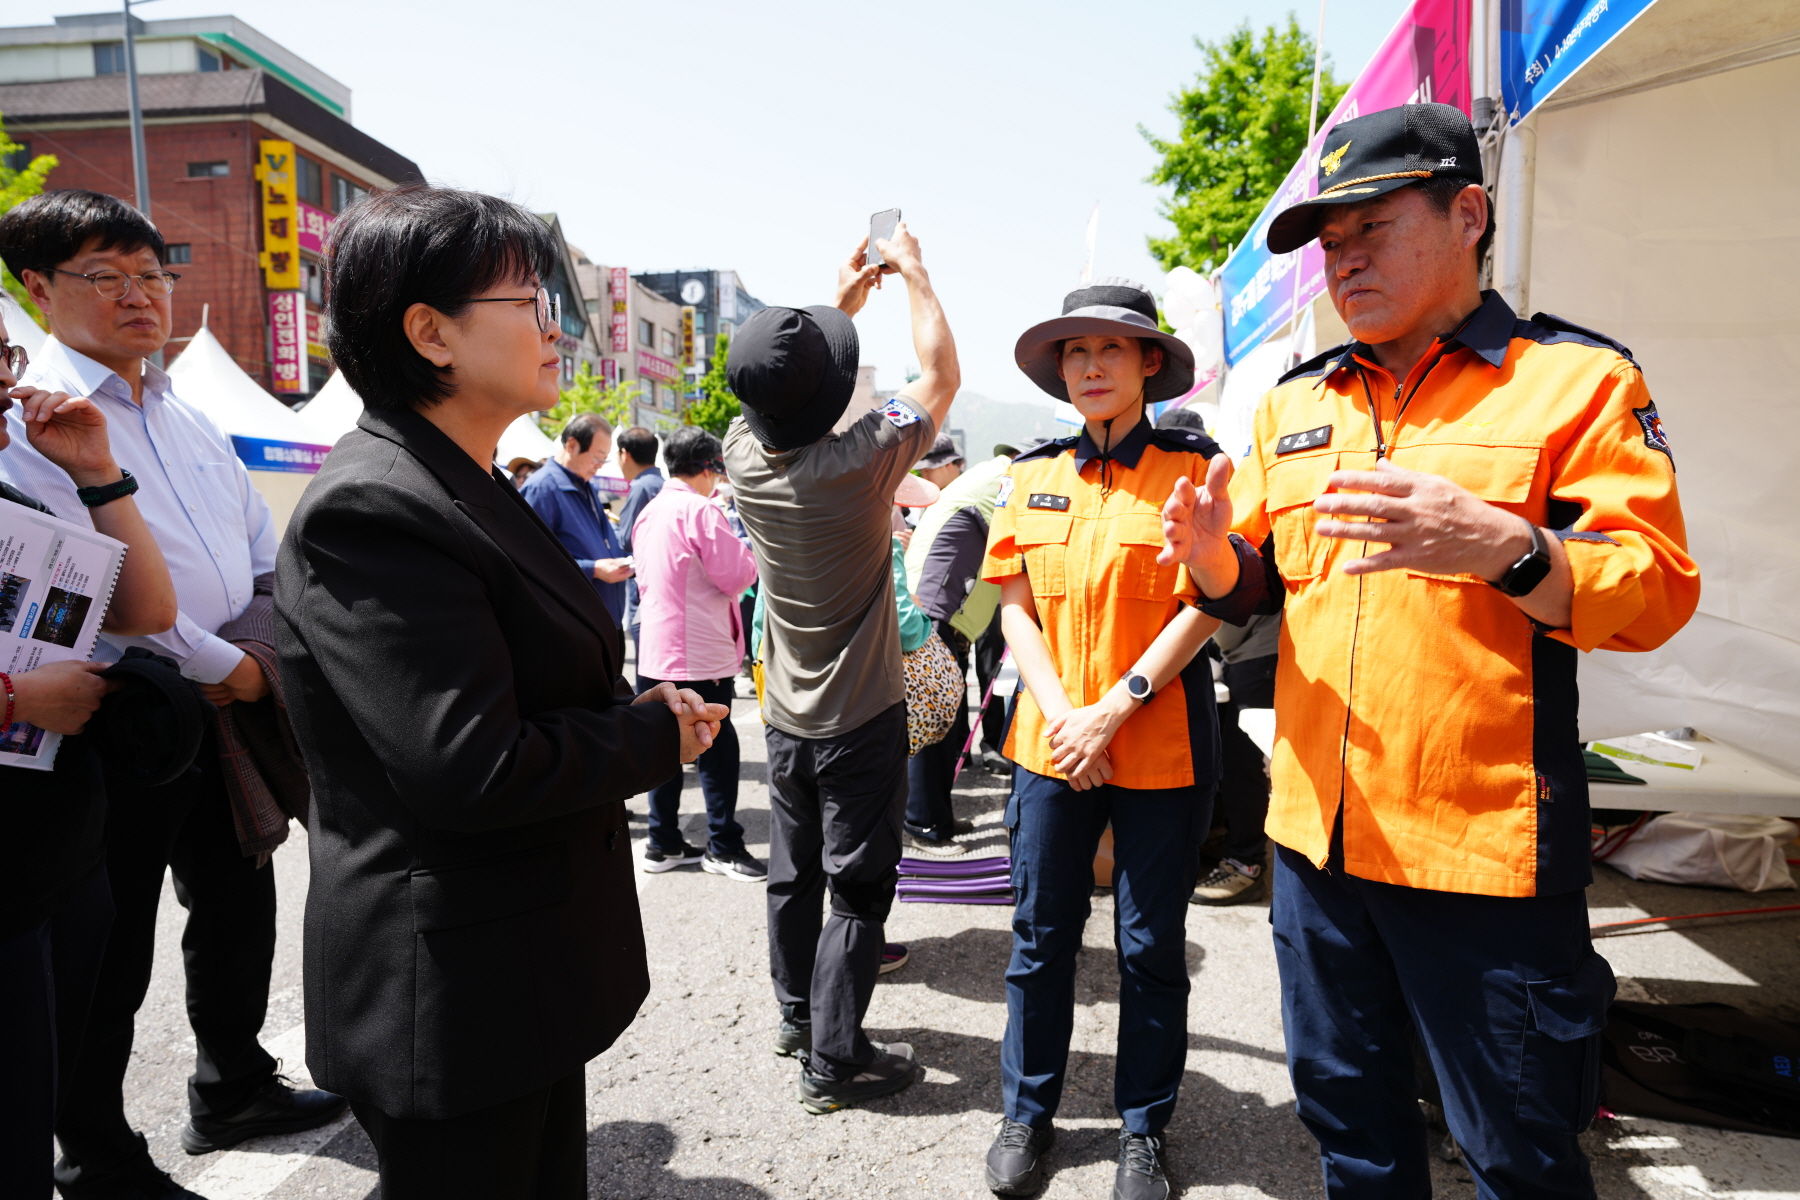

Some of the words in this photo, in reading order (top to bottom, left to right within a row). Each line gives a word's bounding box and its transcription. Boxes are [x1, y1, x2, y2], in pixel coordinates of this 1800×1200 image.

[1525, 59, 1545, 84] 주최
[268, 186, 291, 273] 노래방
[1773, 1055, 1793, 1077] AED
